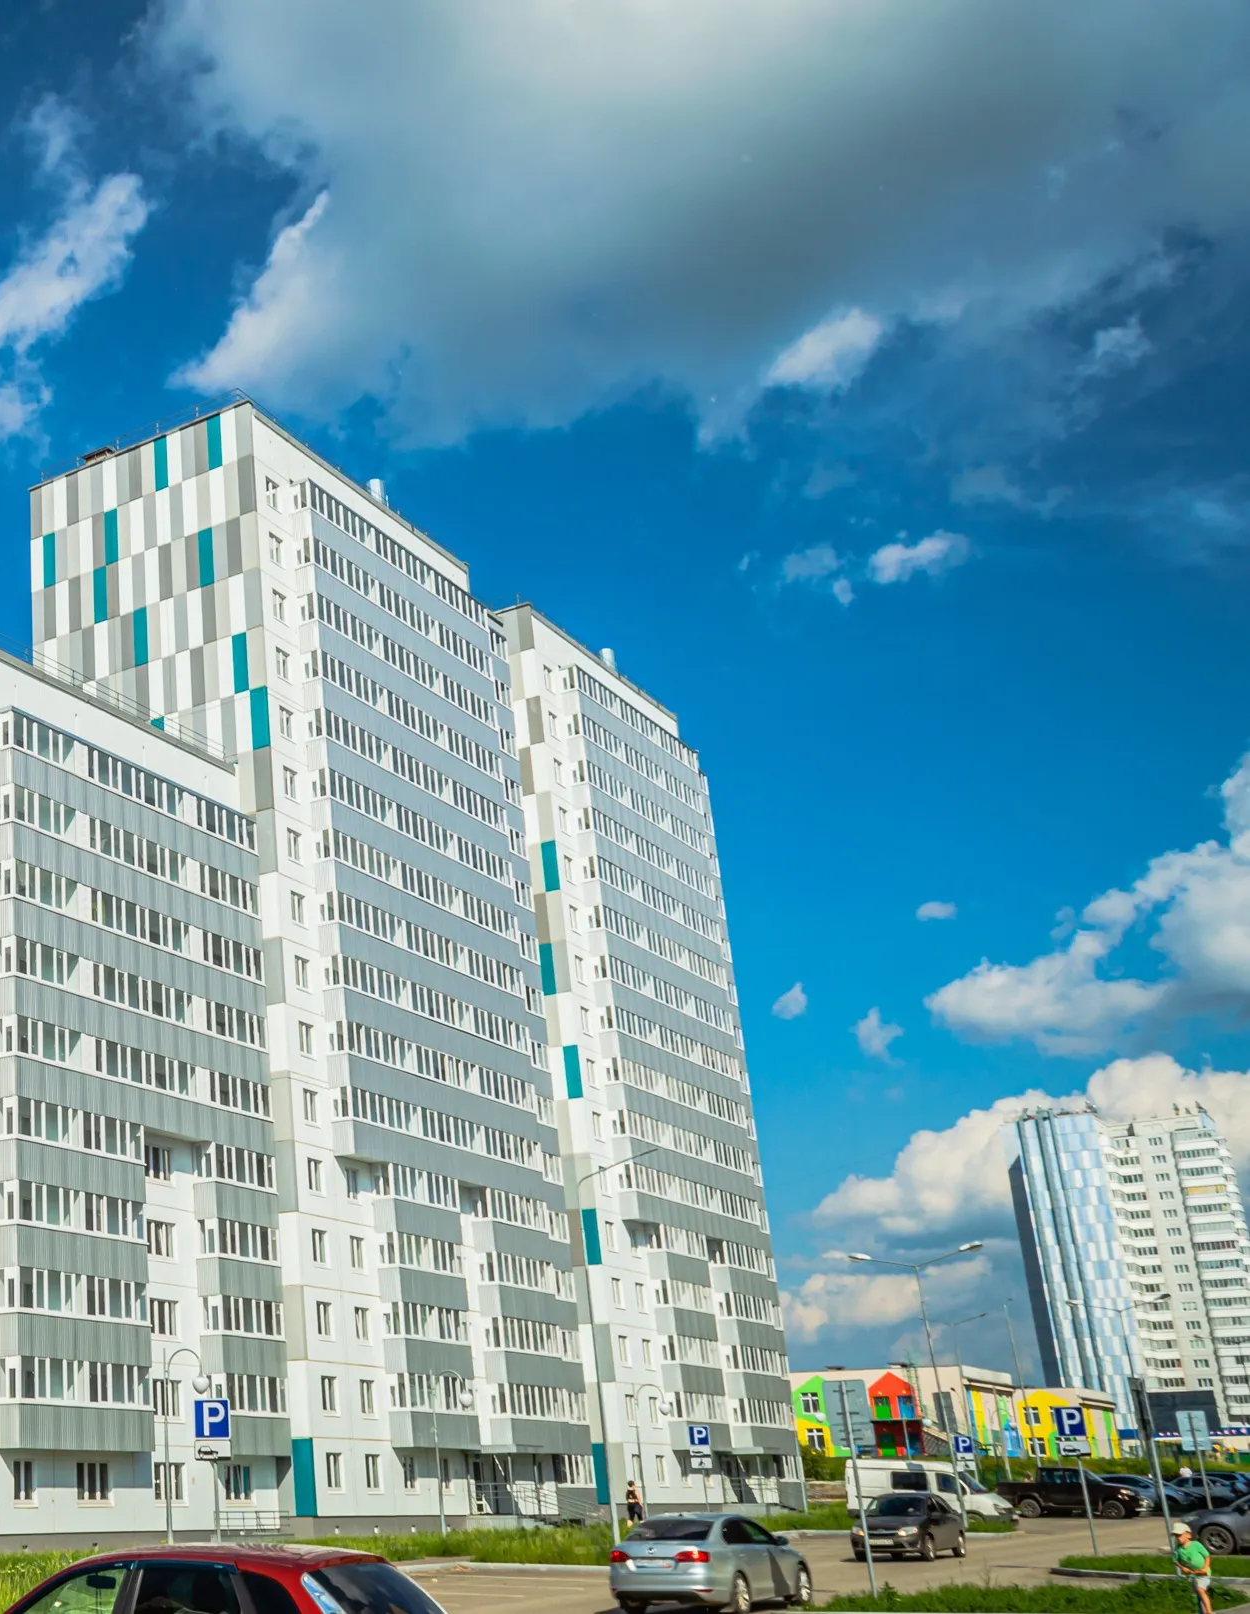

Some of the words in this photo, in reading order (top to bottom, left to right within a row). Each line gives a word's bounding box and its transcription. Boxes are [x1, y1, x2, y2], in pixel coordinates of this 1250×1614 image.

[202, 1402, 226, 1437] P
[1060, 1408, 1081, 1435] P
[693, 1427, 707, 1444] P
[958, 1437, 970, 1452] P
